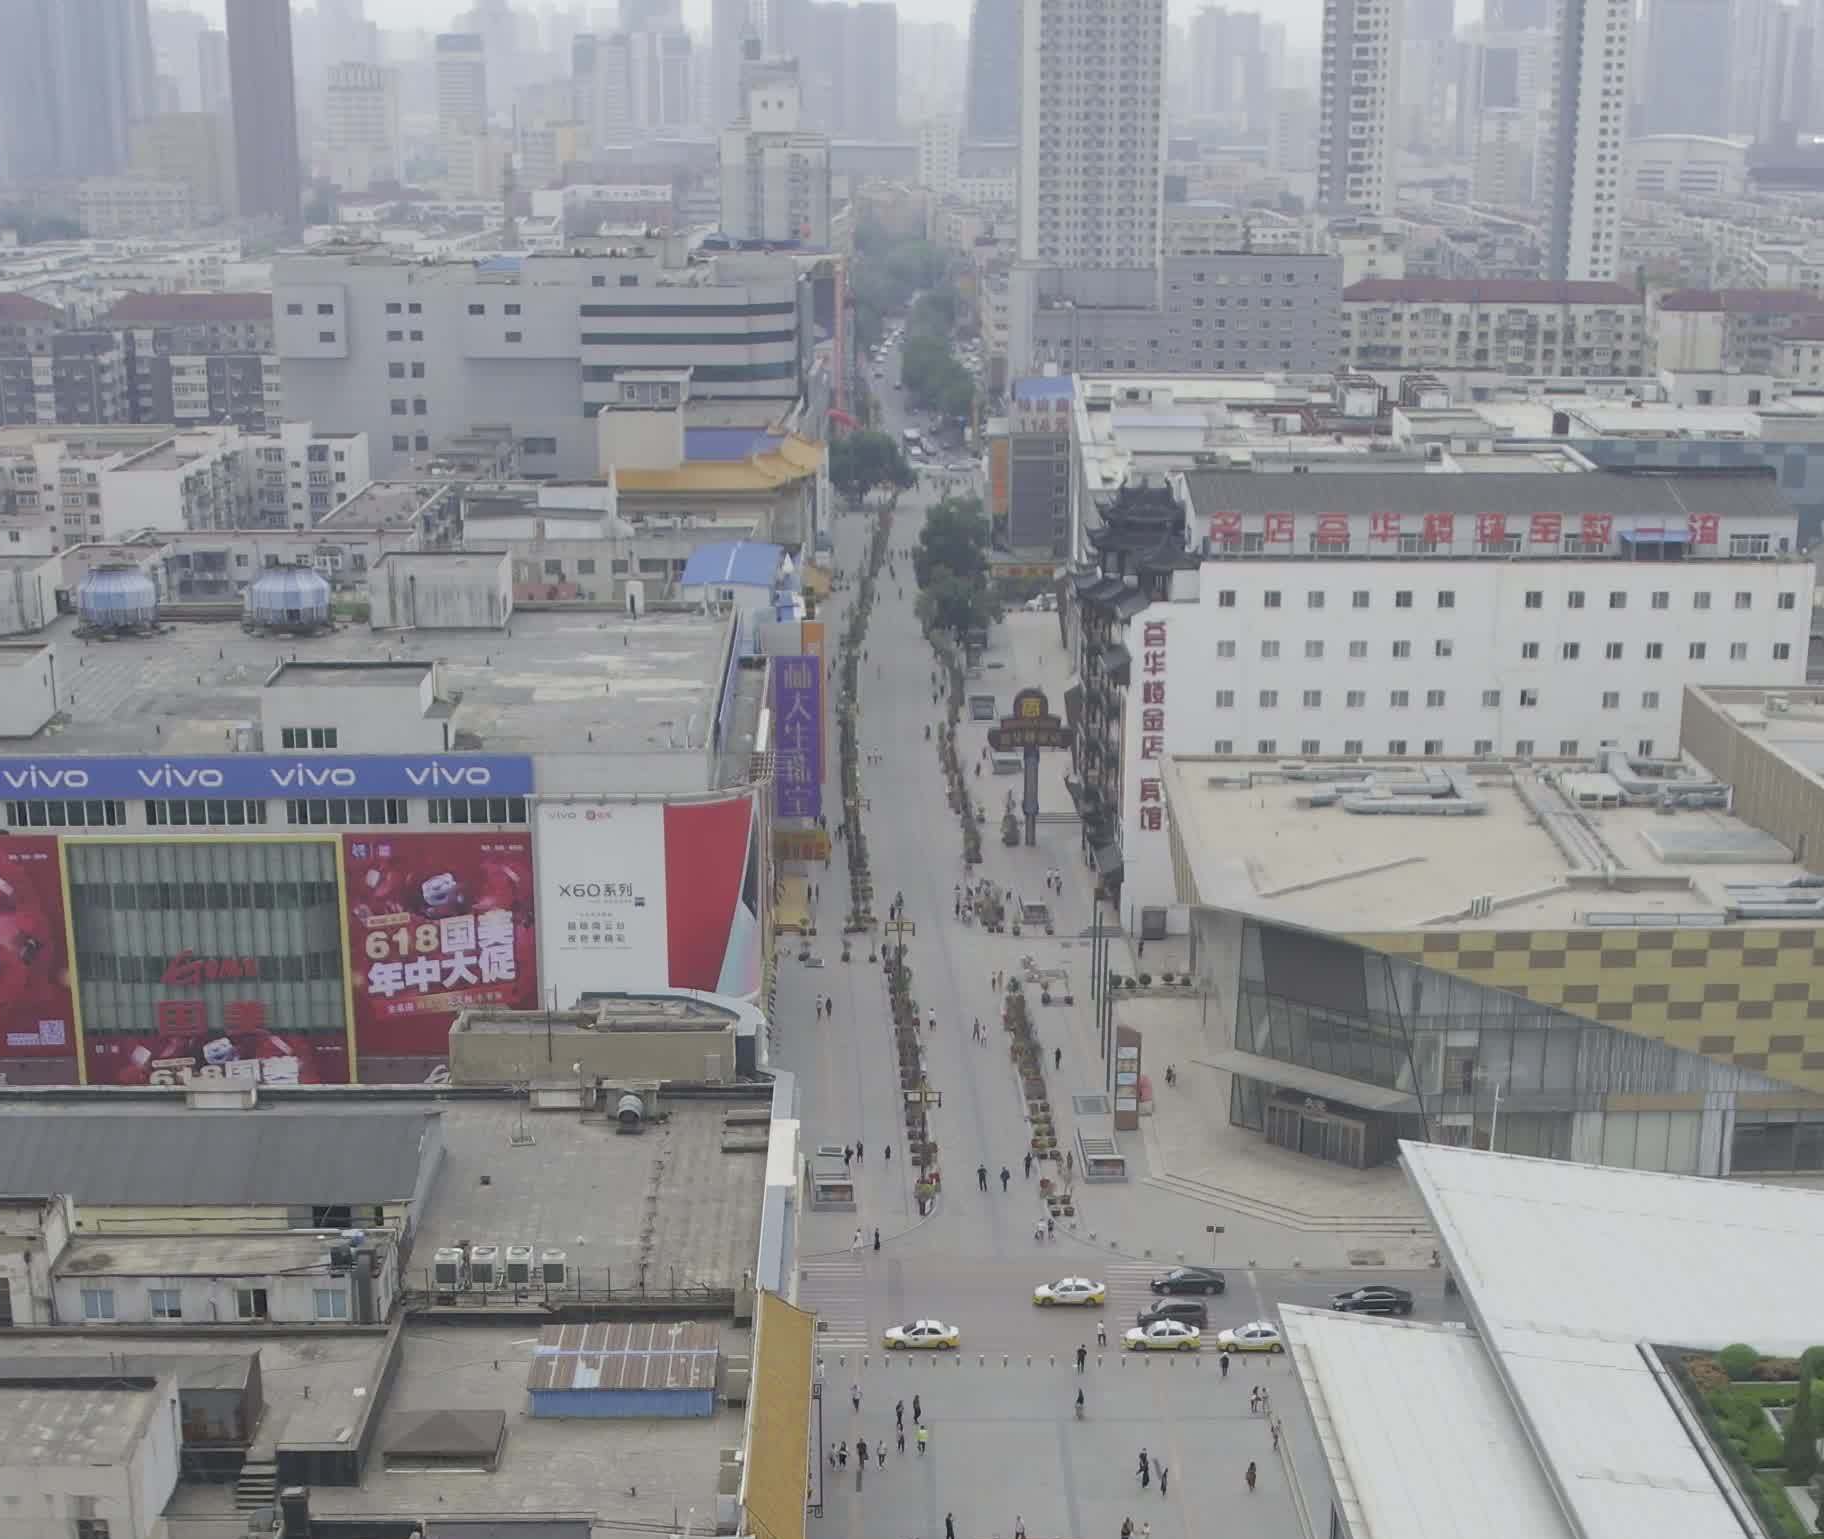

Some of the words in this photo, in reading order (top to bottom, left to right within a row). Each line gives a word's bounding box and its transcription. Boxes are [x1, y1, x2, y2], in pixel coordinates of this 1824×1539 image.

[3, 764, 89, 789] vivo
[138, 763, 224, 788] vivo
[271, 763, 357, 787] vivo
[405, 761, 491, 785] vivo
[1139, 778, 1162, 831] 宾馆
[364, 908, 515, 961] 618国美
[367, 948, 517, 998] 年中大促
[157, 1000, 269, 1034] 国美
